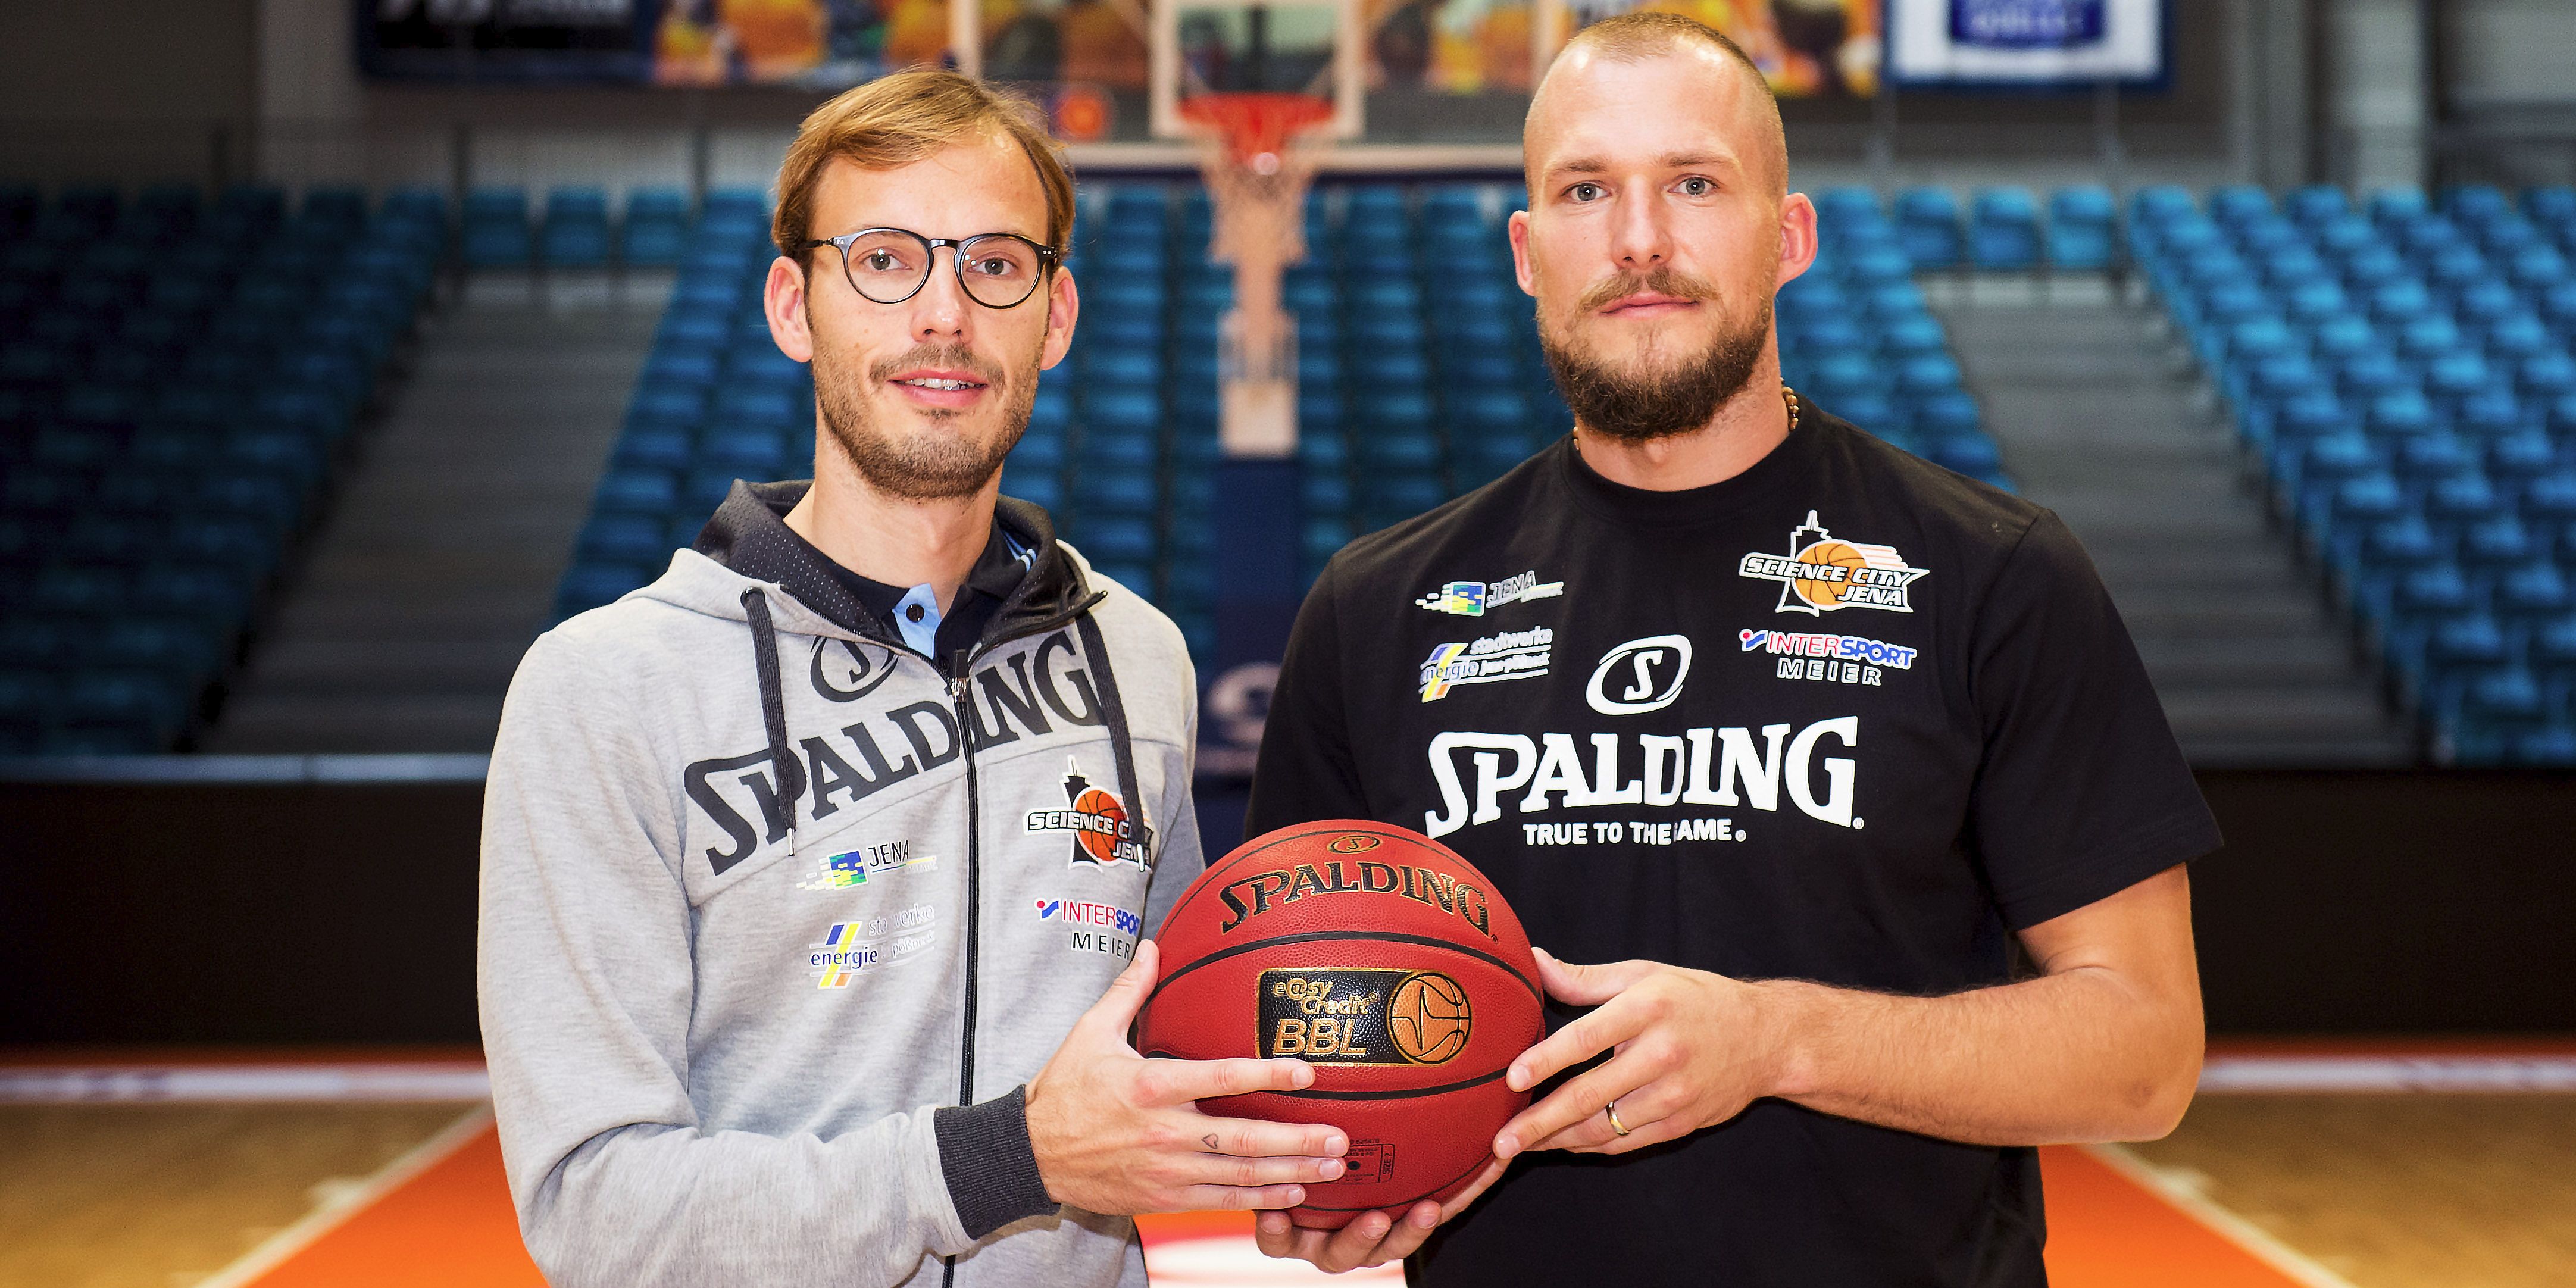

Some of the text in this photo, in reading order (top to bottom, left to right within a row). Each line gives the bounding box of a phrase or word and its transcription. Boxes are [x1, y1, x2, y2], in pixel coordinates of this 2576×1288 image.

[1747, 557, 1911, 587] SCIENCE CITY
[1487, 570, 1536, 603] JENA
[1837, 586, 1902, 606] JENA
[1767, 632, 1917, 668] INTERSPORT
[1778, 658, 1881, 685] MEIER
[1425, 715, 1858, 840] SPALDING
[1028, 812, 1114, 835] SCIENCE
[1523, 818, 1732, 846] TRUE TO THE AME
[867, 840, 909, 867] JENA
[1219, 861, 1490, 937] SPALDING
[811, 946, 878, 970] energie
[1073, 932, 1131, 960] MEIER
[1272, 977, 1334, 1001] e@sy
[1272, 1018, 1368, 1056] BBL
